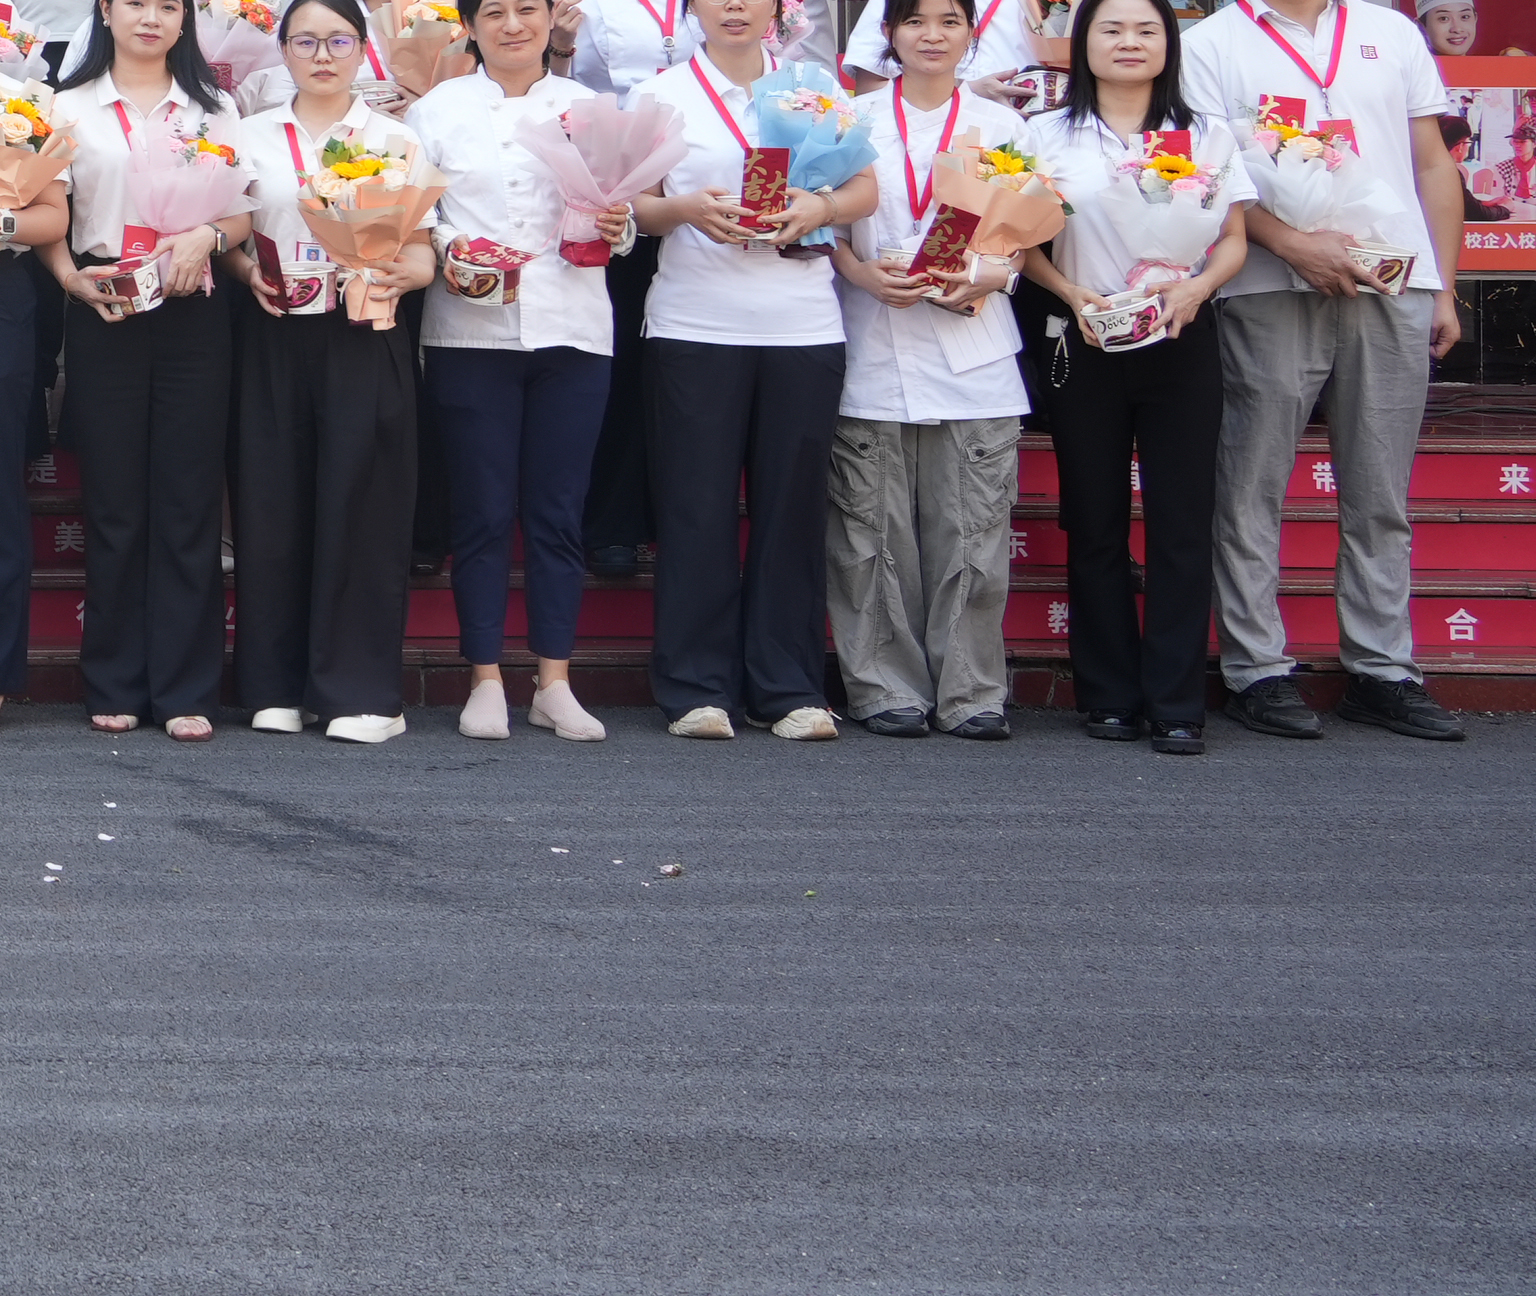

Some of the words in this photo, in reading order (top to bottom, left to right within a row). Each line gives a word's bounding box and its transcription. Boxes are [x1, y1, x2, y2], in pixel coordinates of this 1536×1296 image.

[744, 147, 767, 202] 大吉
[922, 204, 957, 256] 大吉
[1095, 315, 1129, 334] Dove
[1499, 463, 1530, 495] 来
[53, 521, 86, 553] 美
[1445, 608, 1479, 642] 合
